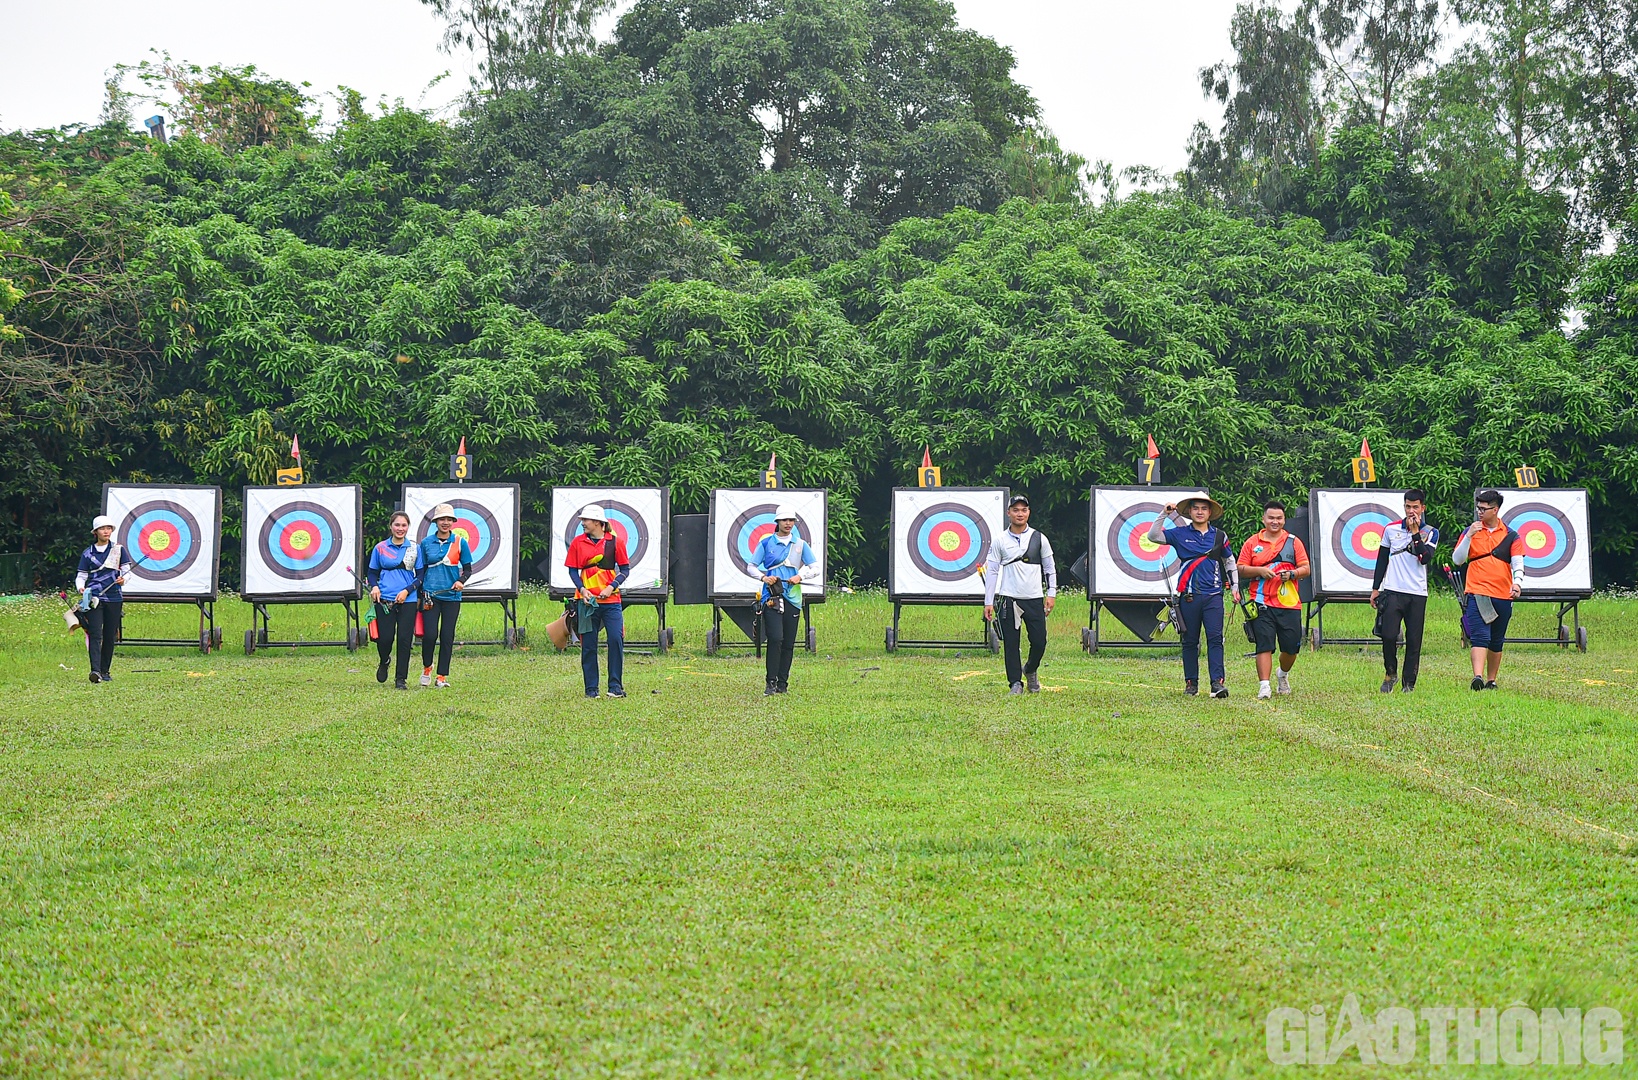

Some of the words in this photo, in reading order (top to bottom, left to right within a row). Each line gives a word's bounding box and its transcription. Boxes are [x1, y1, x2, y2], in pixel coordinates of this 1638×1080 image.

[455, 455, 468, 478] 3
[1143, 460, 1155, 482] 7
[1357, 458, 1370, 481] 8
[279, 474, 301, 483] 2
[766, 471, 777, 488] 5
[925, 469, 936, 487] 6
[1517, 468, 1537, 485] 10
